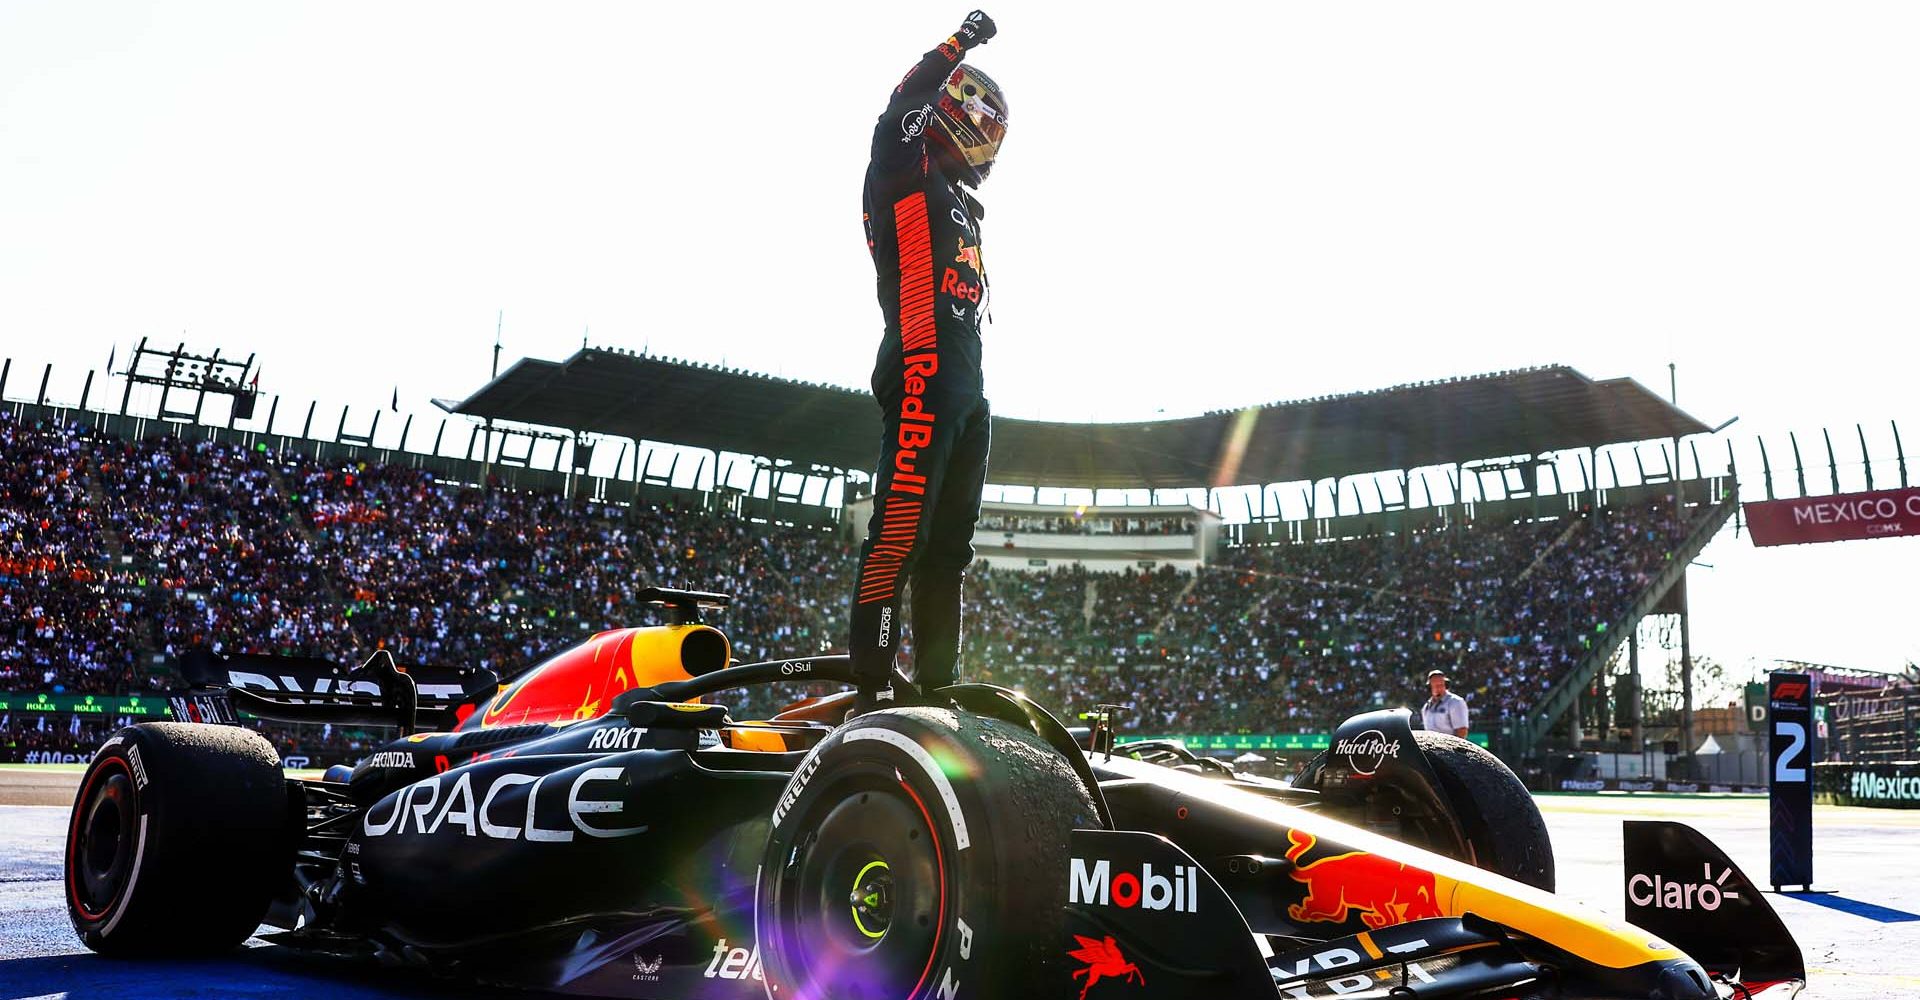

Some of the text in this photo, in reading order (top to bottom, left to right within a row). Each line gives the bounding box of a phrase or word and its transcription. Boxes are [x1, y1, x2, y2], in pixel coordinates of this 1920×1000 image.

[901, 103, 933, 143] Hard Rock
[941, 267, 981, 304] Red
[1793, 499, 1897, 525] MEXICO
[880, 606, 892, 648] sparco
[795, 661, 811, 672] Sui
[26, 703, 56, 711] ROLEX
[74, 705, 103, 713] ROLEX
[119, 706, 147, 714] ROLEX
[170, 696, 221, 724] Mobil
[588, 728, 648, 749] ROKT
[1335, 739, 1400, 758] Hard Rock
[1775, 722, 1806, 782] 2
[127, 744, 148, 791] PIRELLI
[370, 752, 416, 768] HONDA
[772, 745, 822, 828] PIRELLI
[363, 766, 649, 842] ORACLE
[1069, 858, 1197, 913] Mobil
[1628, 873, 1722, 911] Claro
